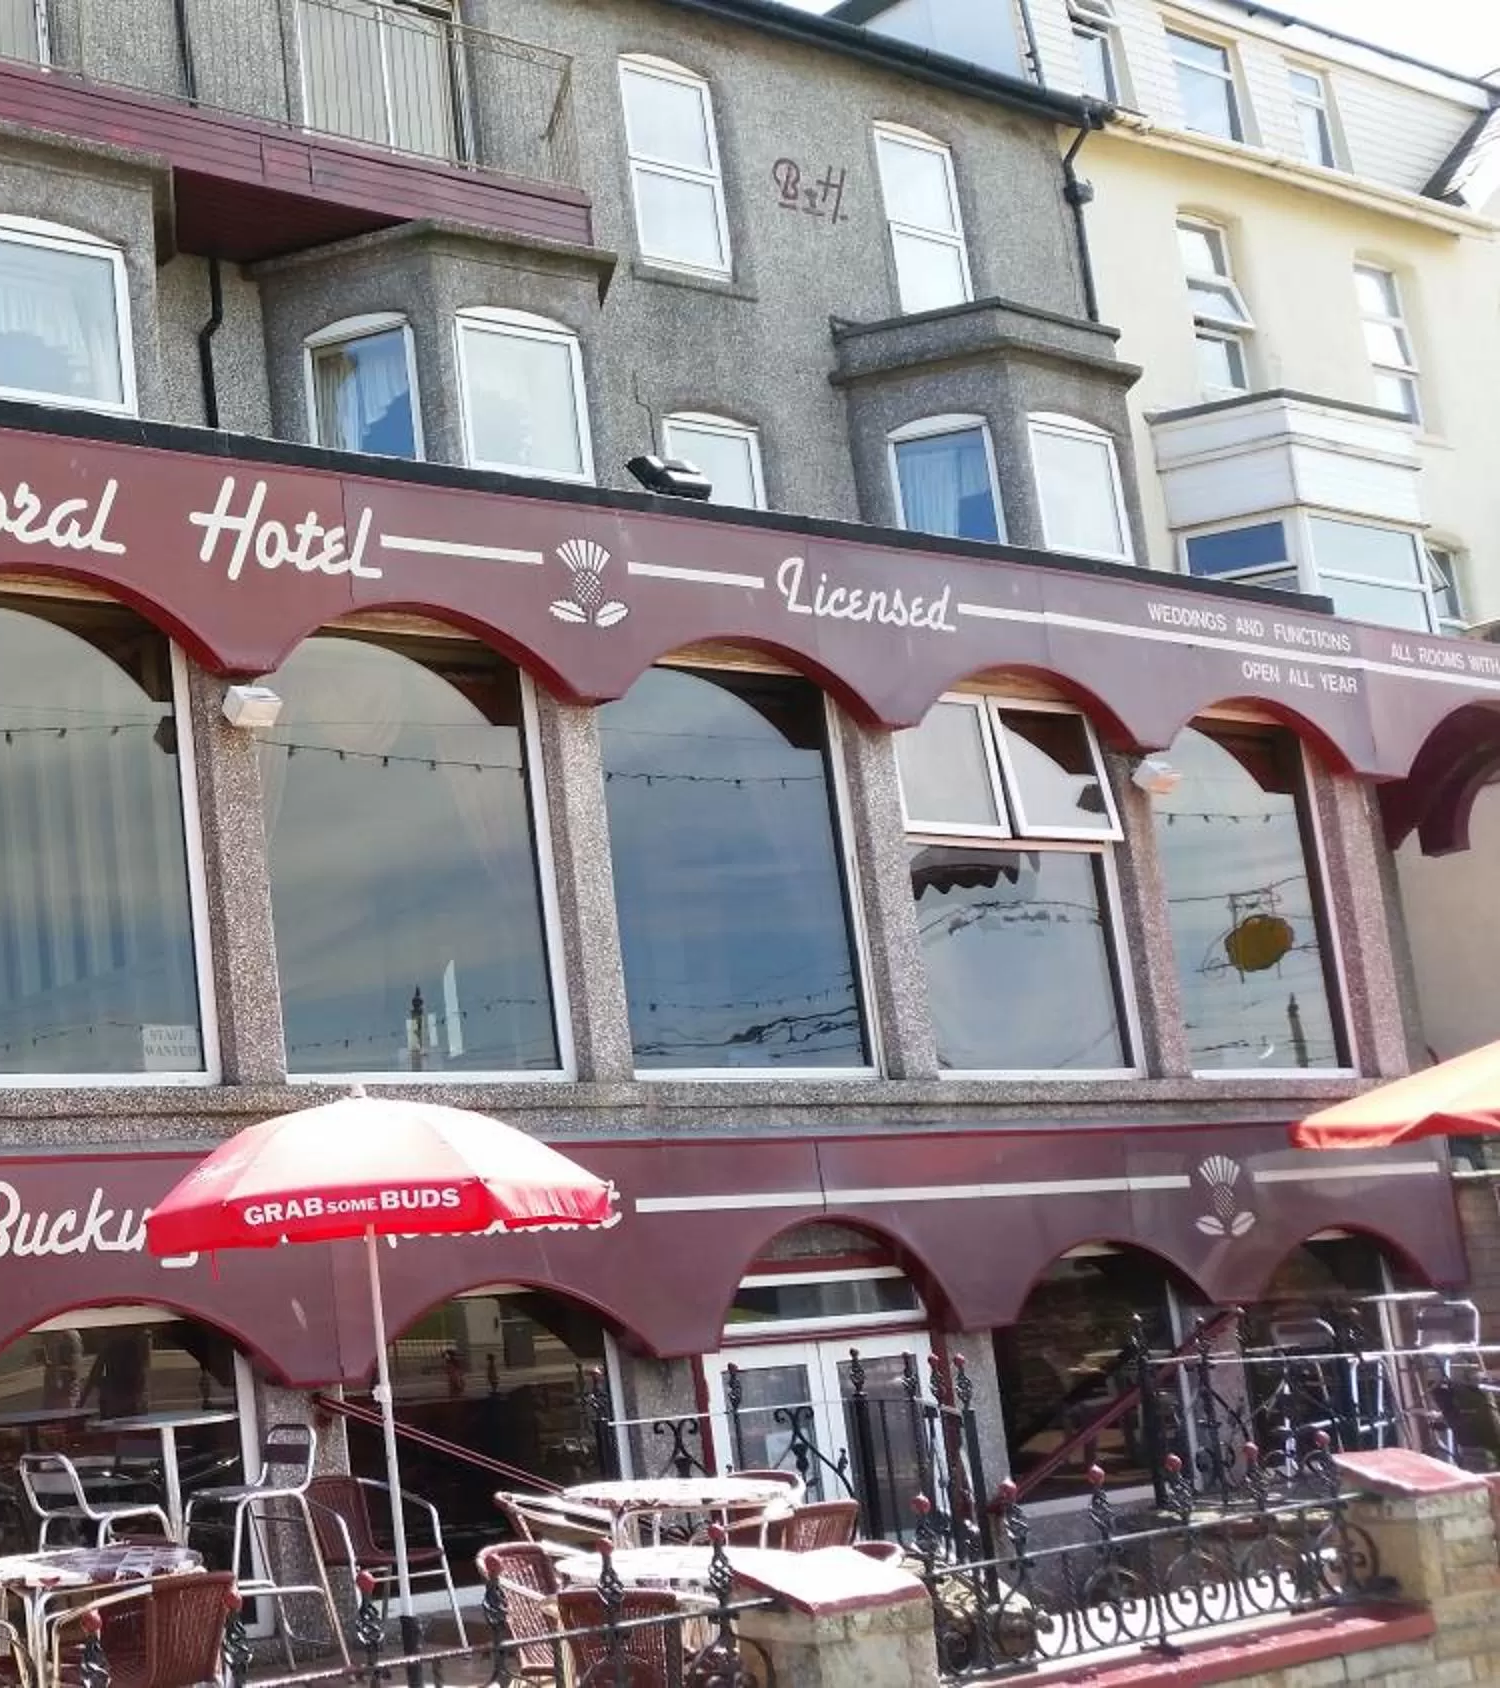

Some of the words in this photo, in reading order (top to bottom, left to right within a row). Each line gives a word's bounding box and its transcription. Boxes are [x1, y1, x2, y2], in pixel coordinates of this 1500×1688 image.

[190, 476, 383, 581] Hotel
[777, 557, 956, 632] Licensed
[1148, 603, 1227, 632] WEDDINGS
[1235, 616, 1264, 637] AND
[1273, 623, 1351, 652] FUNCTIONS
[1241, 660, 1281, 684] OPEN
[1288, 669, 1314, 689] ALL
[1319, 672, 1358, 694] YEAR
[1390, 642, 1414, 662] ALL
[1417, 647, 1464, 670] ROOMS
[1467, 655, 1500, 675] WITH
[243, 1197, 324, 1226] GRAB
[326, 1197, 379, 1214] SOME
[380, 1187, 461, 1211] BUDS
